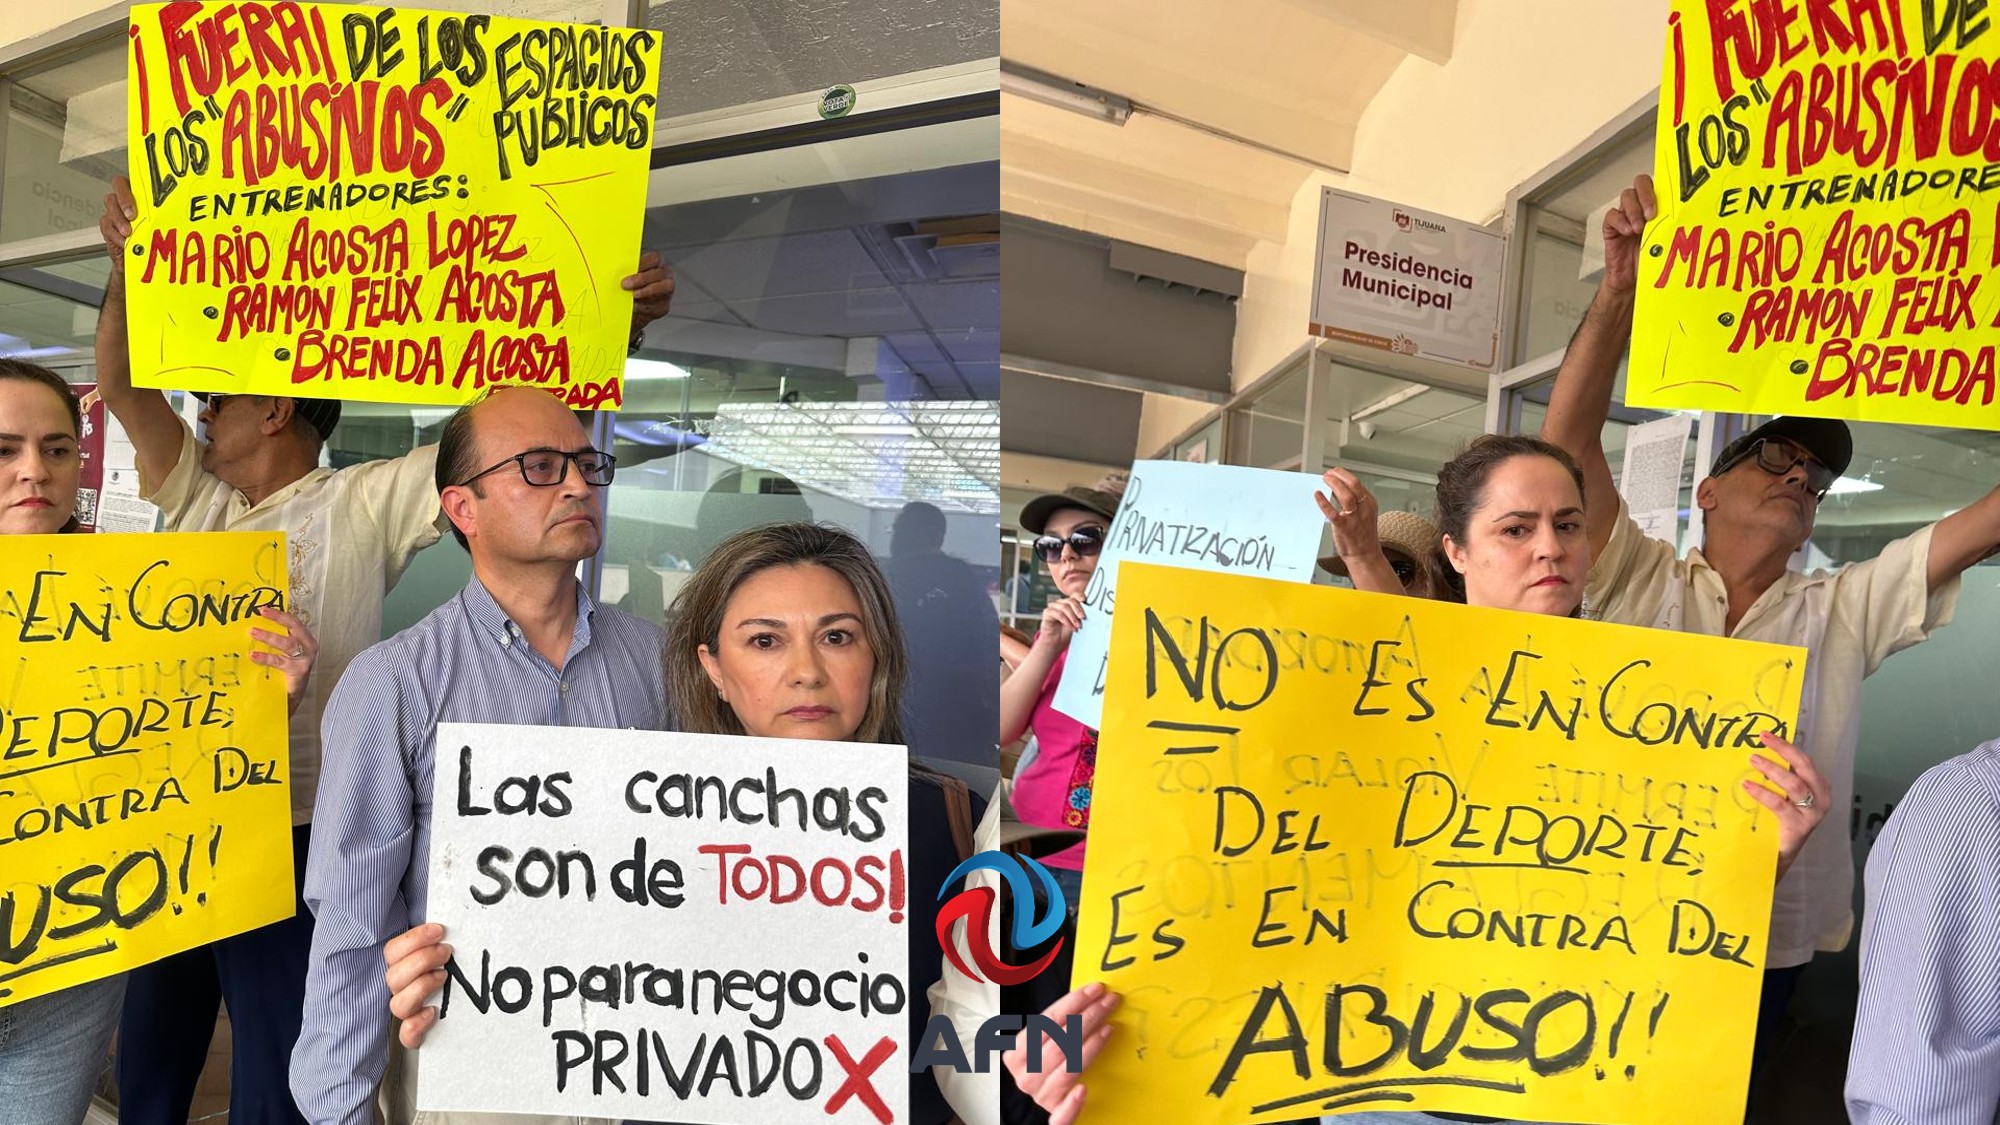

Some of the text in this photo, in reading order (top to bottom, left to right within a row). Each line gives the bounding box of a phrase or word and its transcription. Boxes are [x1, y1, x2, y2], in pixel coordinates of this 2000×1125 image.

[342, 8, 405, 82] DE
[418, 15, 490, 87] LOS
[1921, 0, 1991, 56] DE
[144, 110, 210, 207] LOS
[1675, 95, 1750, 202] LOS
[141, 213, 527, 287] MARIO ACOSTA LOPEZ
[1414, 218, 1446, 233] TIJUANA
[1654, 220, 1804, 292] MARIO
[1811, 208, 1971, 284] ACOSTA
[1342, 268, 1452, 311] Municipal
[1344, 240, 1473, 290] Presidencia
[217, 268, 566, 342] RAMON FELIX ACOSTA
[1728, 269, 1982, 353] RAMON FELIX
[291, 329, 570, 390] BRENDA ACOSTA
[1805, 338, 1996, 406] BRENDA
[19, 560, 285, 642] EN CONTRA
[1145, 607, 1274, 711] NO
[1485, 650, 1582, 740] EN
[0, 691, 235, 762] EPORTE,
[214, 747, 283, 793] DEL
[457, 746, 888, 842] Las canchas
[1212, 786, 1330, 857] DEL
[470, 836, 905, 925] son de TODOS!
[1252, 885, 1348, 948] EN
[1408, 880, 1636, 955] CONTRA
[1668, 899, 1754, 968] DEL
[441, 948, 902, 1029] No para negocio
[554, 1029, 823, 1100] PRIVADO
[1206, 980, 1669, 1099] ABUSO!!
